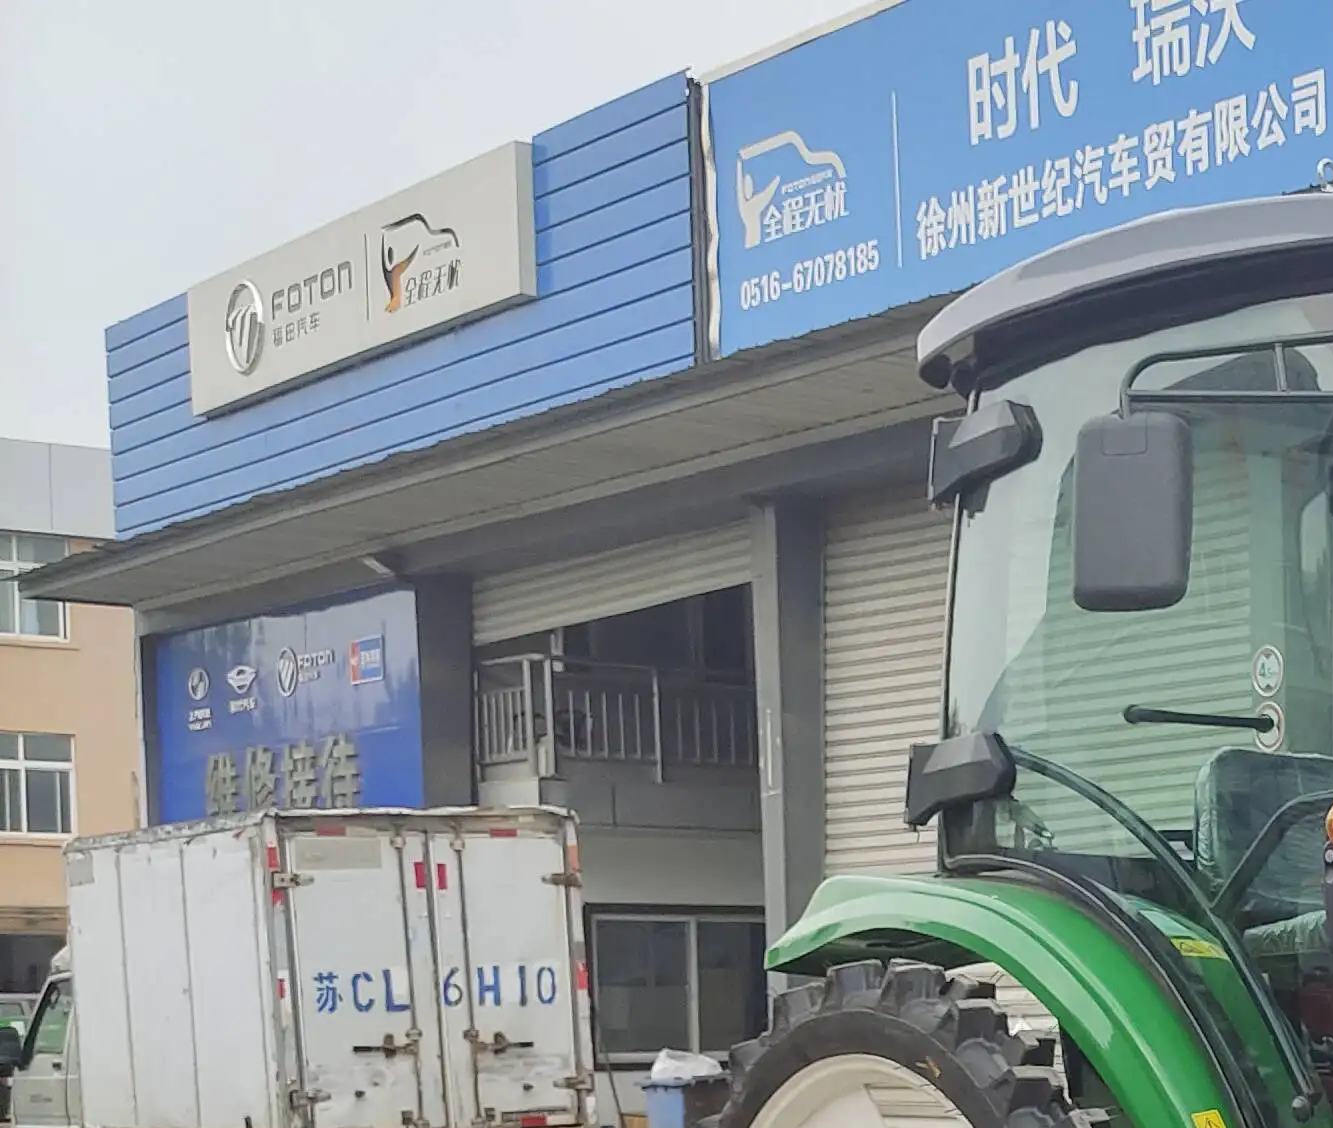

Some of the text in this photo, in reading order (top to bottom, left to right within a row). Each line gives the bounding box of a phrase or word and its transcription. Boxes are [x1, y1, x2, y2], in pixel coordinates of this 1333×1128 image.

[967, 20, 1079, 146] 时代
[915, 68, 1328, 261] 徐州新世纪汽车贸有限公司
[271, 260, 352, 320] FOTON
[740, 239, 880, 311] 0516-67078185
